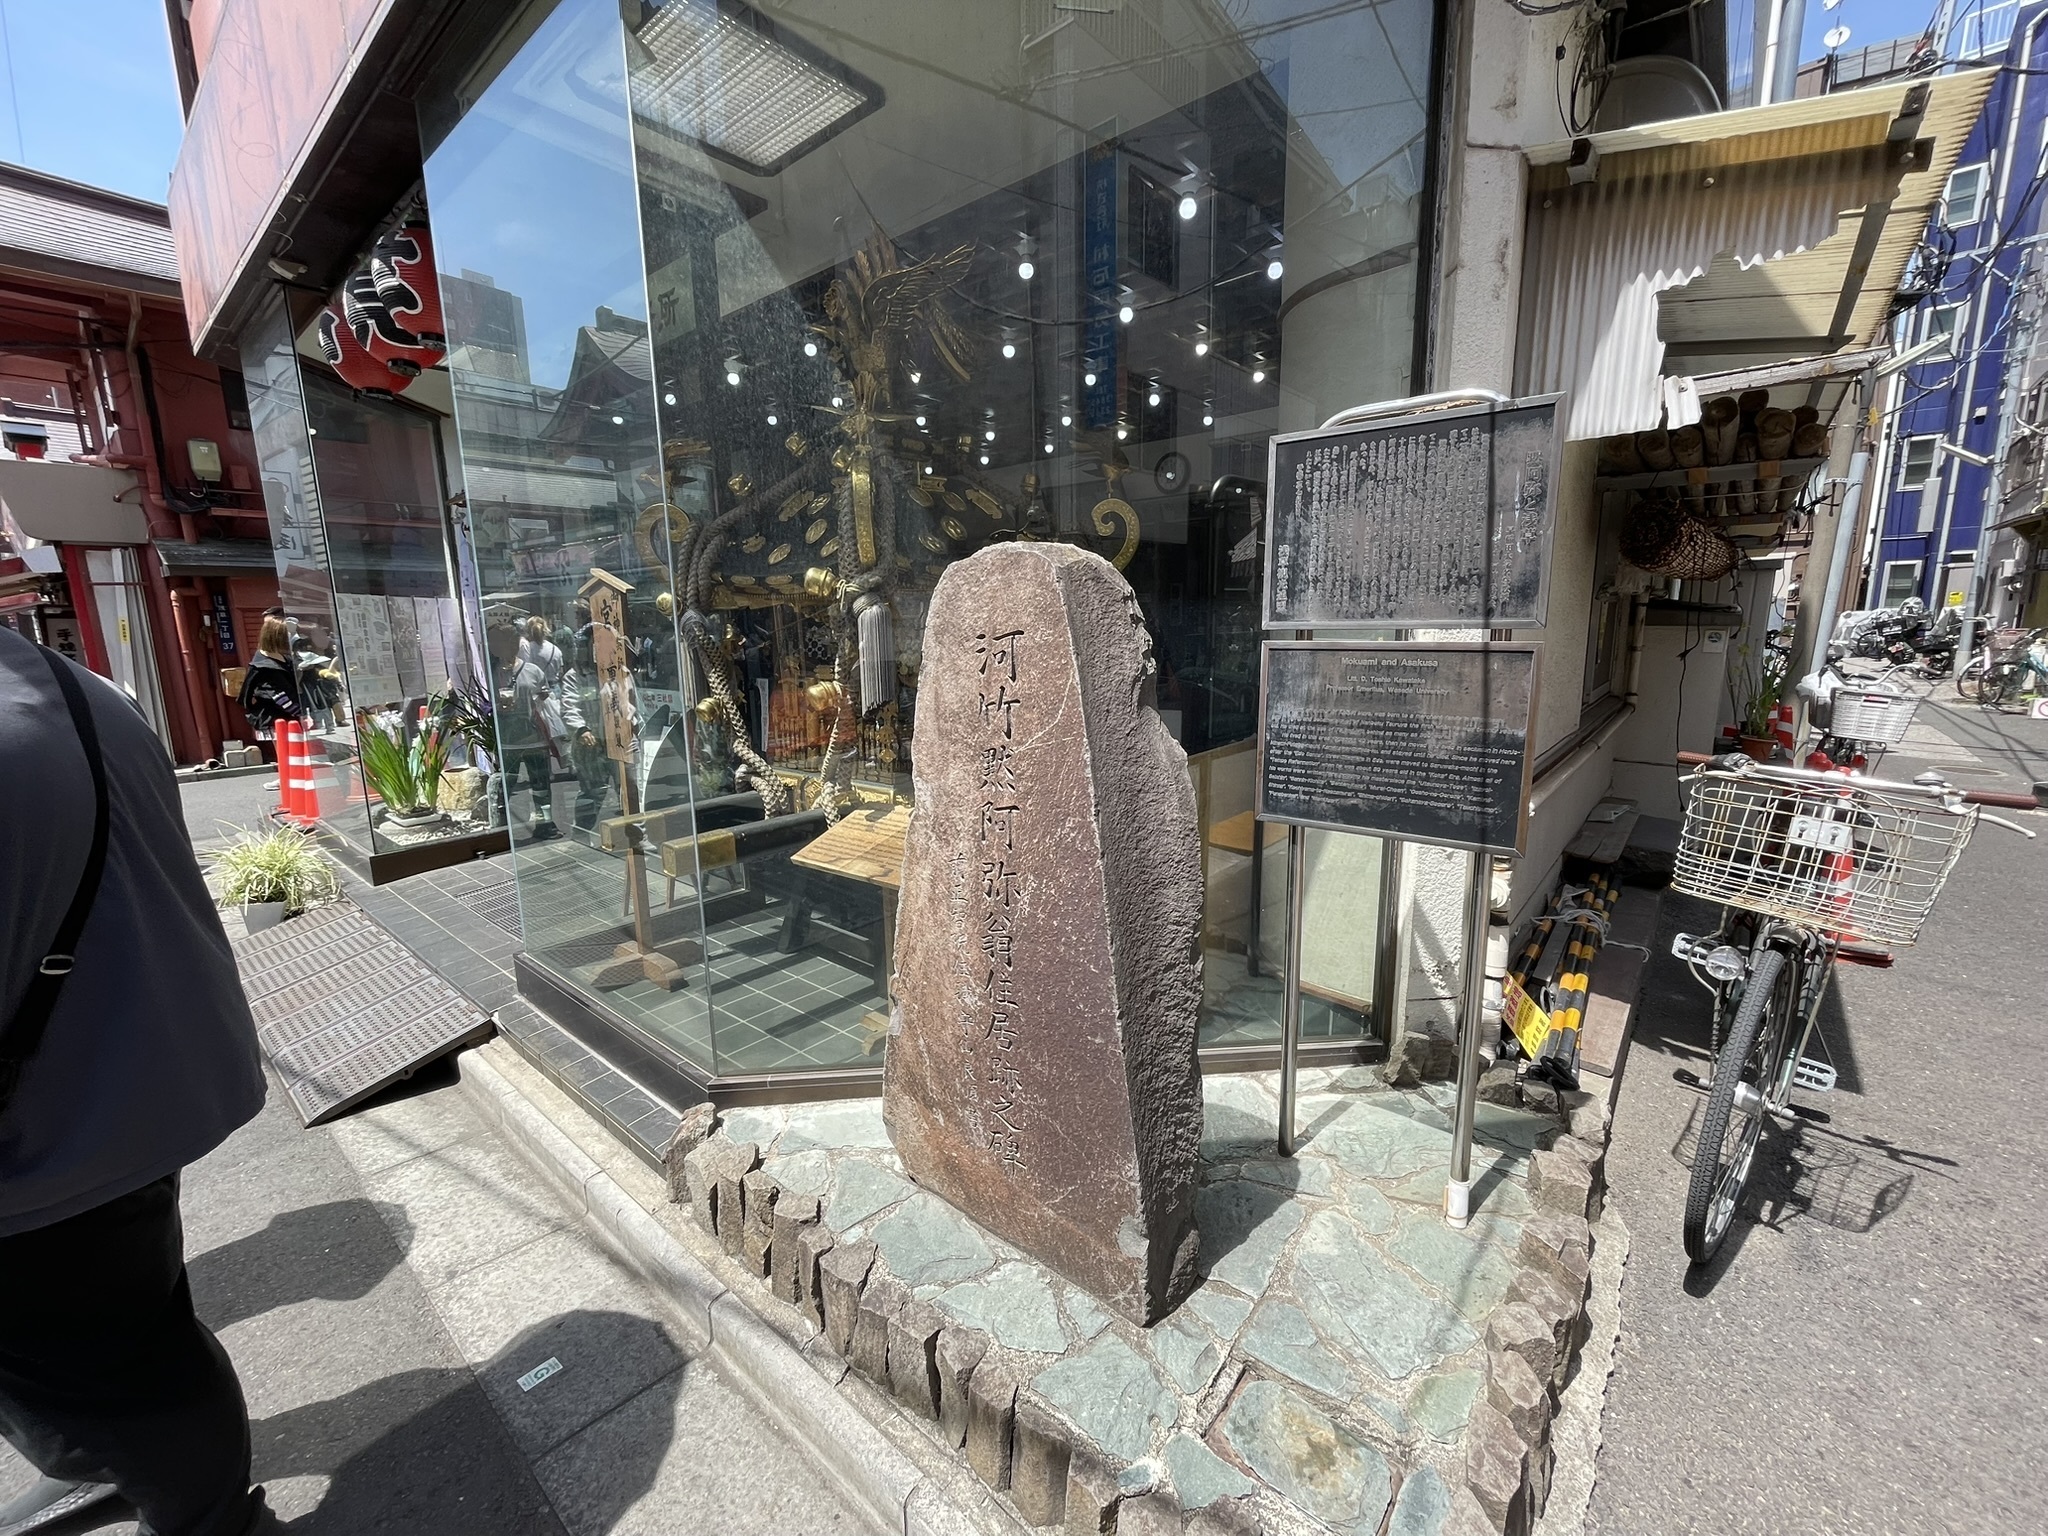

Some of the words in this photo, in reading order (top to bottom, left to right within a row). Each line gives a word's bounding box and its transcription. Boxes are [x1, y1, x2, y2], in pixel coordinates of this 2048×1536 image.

[222, 642, 234, 650] 37
[1341, 657, 1378, 666] Mokuami
[1381, 658, 1397, 666] and
[1400, 658, 1438, 667] Asakusa
